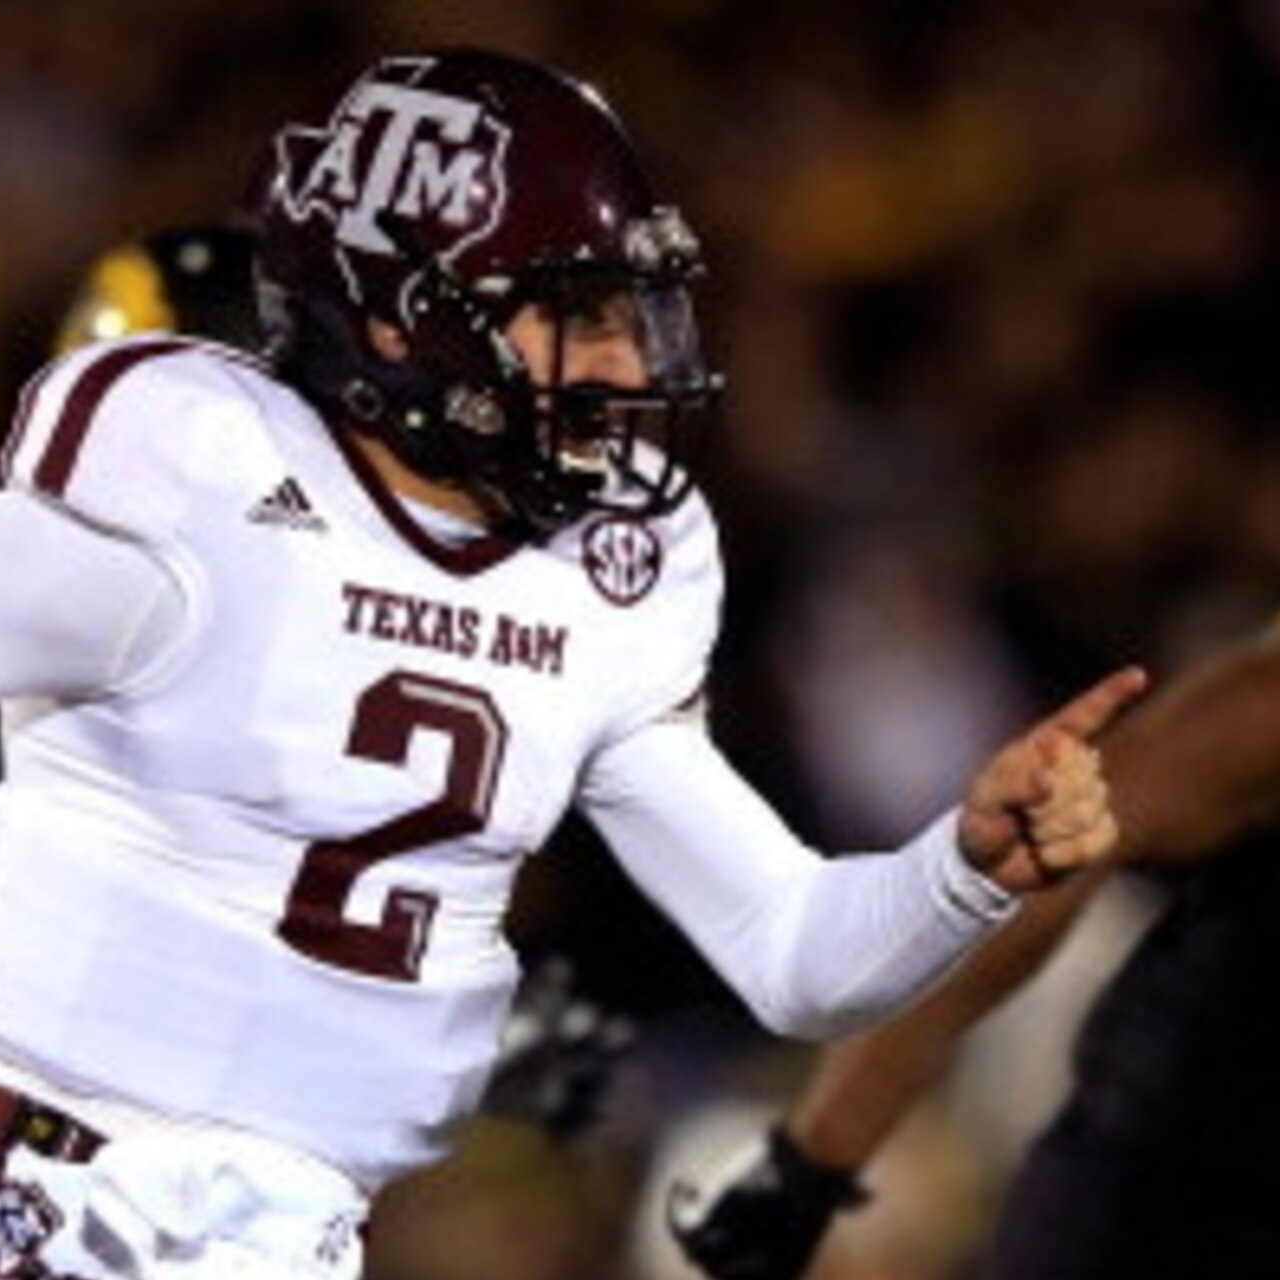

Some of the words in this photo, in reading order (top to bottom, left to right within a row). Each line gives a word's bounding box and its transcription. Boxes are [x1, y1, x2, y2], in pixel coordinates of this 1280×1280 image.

[341, 582, 481, 661] TEXAS
[488, 612, 570, 678] A&M
[274, 665, 510, 983] 2
